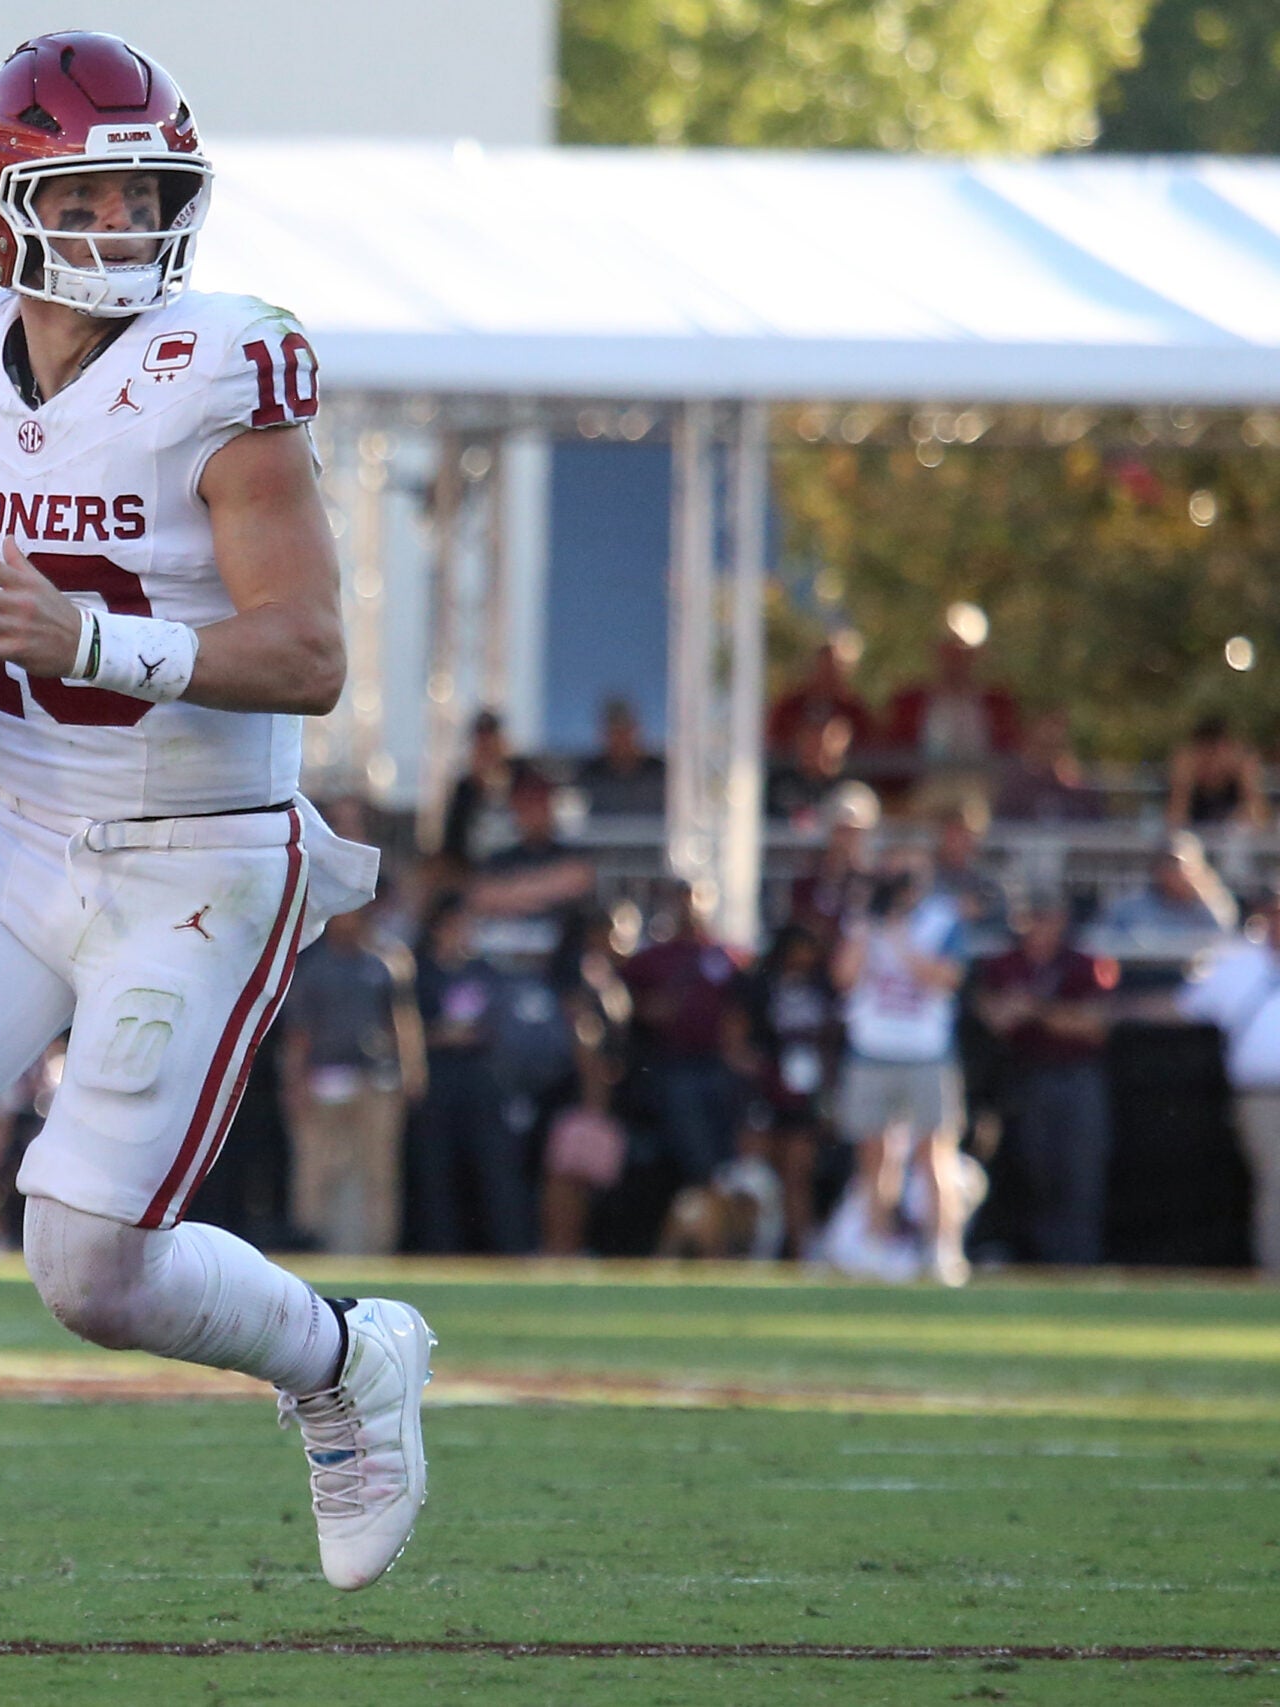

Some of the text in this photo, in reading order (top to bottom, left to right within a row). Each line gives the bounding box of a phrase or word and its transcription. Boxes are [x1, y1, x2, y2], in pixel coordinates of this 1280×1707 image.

[107, 131, 152, 143] OKLAHOMA
[143, 331, 197, 372] C
[242, 332, 319, 427] 10
[19, 421, 43, 453] SEC
